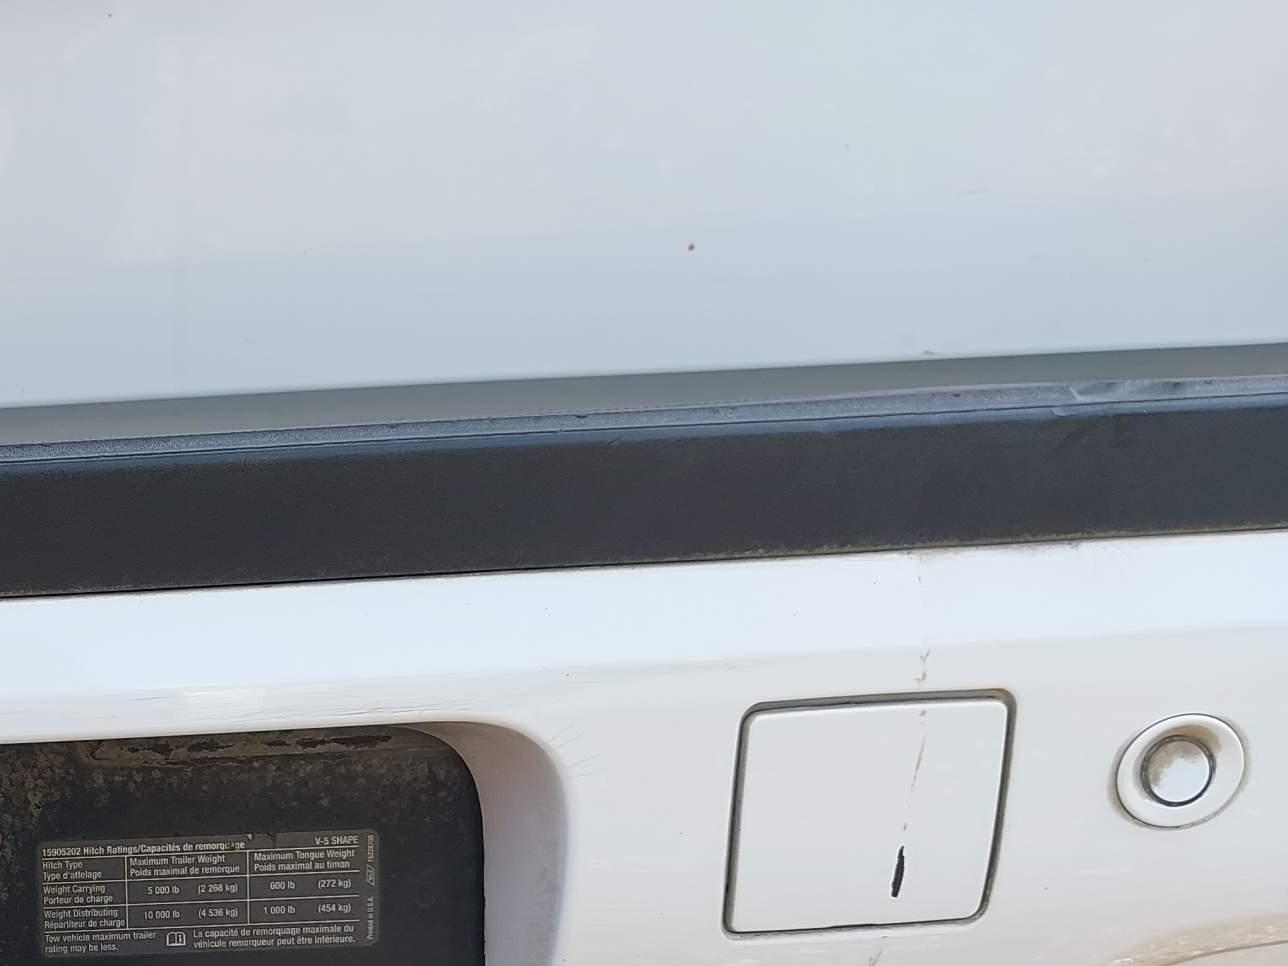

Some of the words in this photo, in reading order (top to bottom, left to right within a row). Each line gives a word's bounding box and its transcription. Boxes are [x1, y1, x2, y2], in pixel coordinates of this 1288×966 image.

[315, 836, 329, 845] V-5
[331, 836, 359, 844] SHAPE
[42, 848, 81, 857] 15905202
[83, 847, 104, 855] Hitch
[107, 843, 181, 855] Ratings/Capacités
[183, 843, 193, 851] de
[130, 857, 169, 865] Maximum
[172, 856, 195, 864] Trailer
[197, 855, 225, 864] Weight
[254, 853, 293, 861] Maximum
[296, 851, 324, 860] Tongue
[327, 850, 355, 859] Weight
[43, 861, 63, 869] Hitch
[65, 861, 83, 869] Type
[254, 863, 276, 871] Poids
[278, 862, 312, 870] maximal
[43, 872, 61, 881] Type
[63, 870, 102, 880] d'attelage
[130, 868, 152, 876] Poids
[153, 867, 187, 876] maximal
[189, 866, 199, 874] de
[202, 865, 240, 874] remorque
[43, 885, 71, 894] Weight
[72, 884, 105, 893] Carrying
[198, 885, 206, 894] (2
[225, 884, 238, 893] kg)
[287, 881, 295, 889] lb
[318, 880, 336, 889] (272
[338, 879, 351, 888] kg)
[155, 886, 170, 894] 000
[172, 886, 179, 894] lb
[44, 896, 72, 904] Porteur
[86, 896, 112, 904] charge
[318, 904, 335, 913] (454
[338, 903, 351, 912] kg)
[44, 909, 71, 919] Weight
[73, 909, 118, 917] Distributing
[144, 911, 153, 919] 10
[155, 911, 170, 919] 000
[198, 909, 206, 918] (4
[208, 909, 223, 917] 536
[225, 909, 238, 917] kg)
[45, 920, 86, 930] Répartiteur
[88, 919, 97, 927] de
[99, 919, 125, 927] charge
[193, 929, 202, 938] La
[205, 928, 239, 938] capacité
[240, 928, 250, 936] de
[253, 926, 300, 936] remorquage
[303, 925, 341, 933] maximale
[45, 935, 60, 943] Tow
[63, 934, 90, 942] vehicle
[92, 933, 131, 941] maximum
[133, 931, 156, 939] trailer
[194, 939, 226, 949] véhicule
[228, 938, 274, 947] remorqueur
[277, 937, 294, 946] peut
[297, 935, 313, 944] être
[45, 944, 68, 953] rating
[70, 944, 87, 952] may
[89, 943, 98, 952] be
[101, 943, 119, 951] less.
